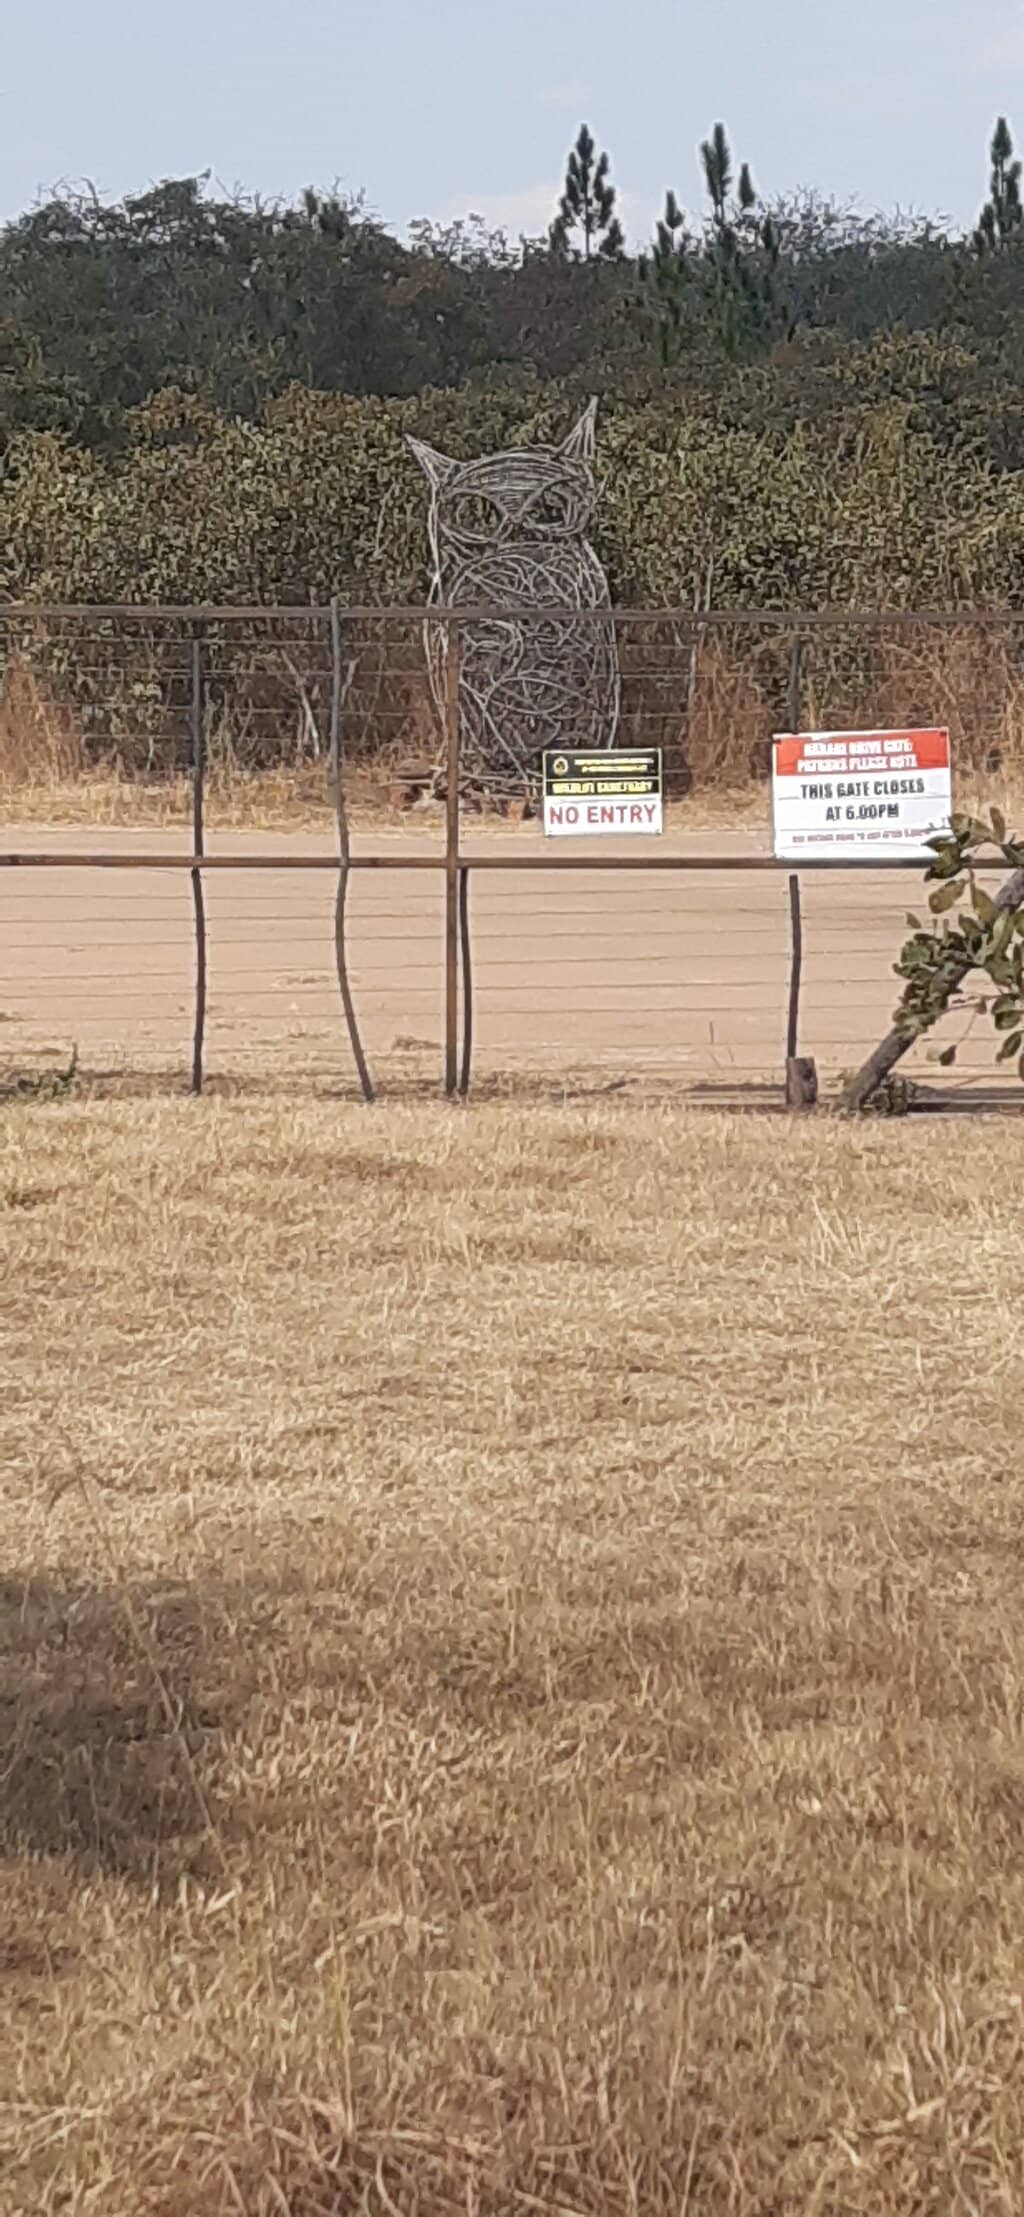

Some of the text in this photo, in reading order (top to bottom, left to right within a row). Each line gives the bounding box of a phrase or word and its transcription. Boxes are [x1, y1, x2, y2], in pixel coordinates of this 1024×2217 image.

[800, 778, 925, 799] THIS GATE CLOSES
[550, 803, 656, 824] NO ENTRY
[826, 803, 899, 821] AT 6.00PM
